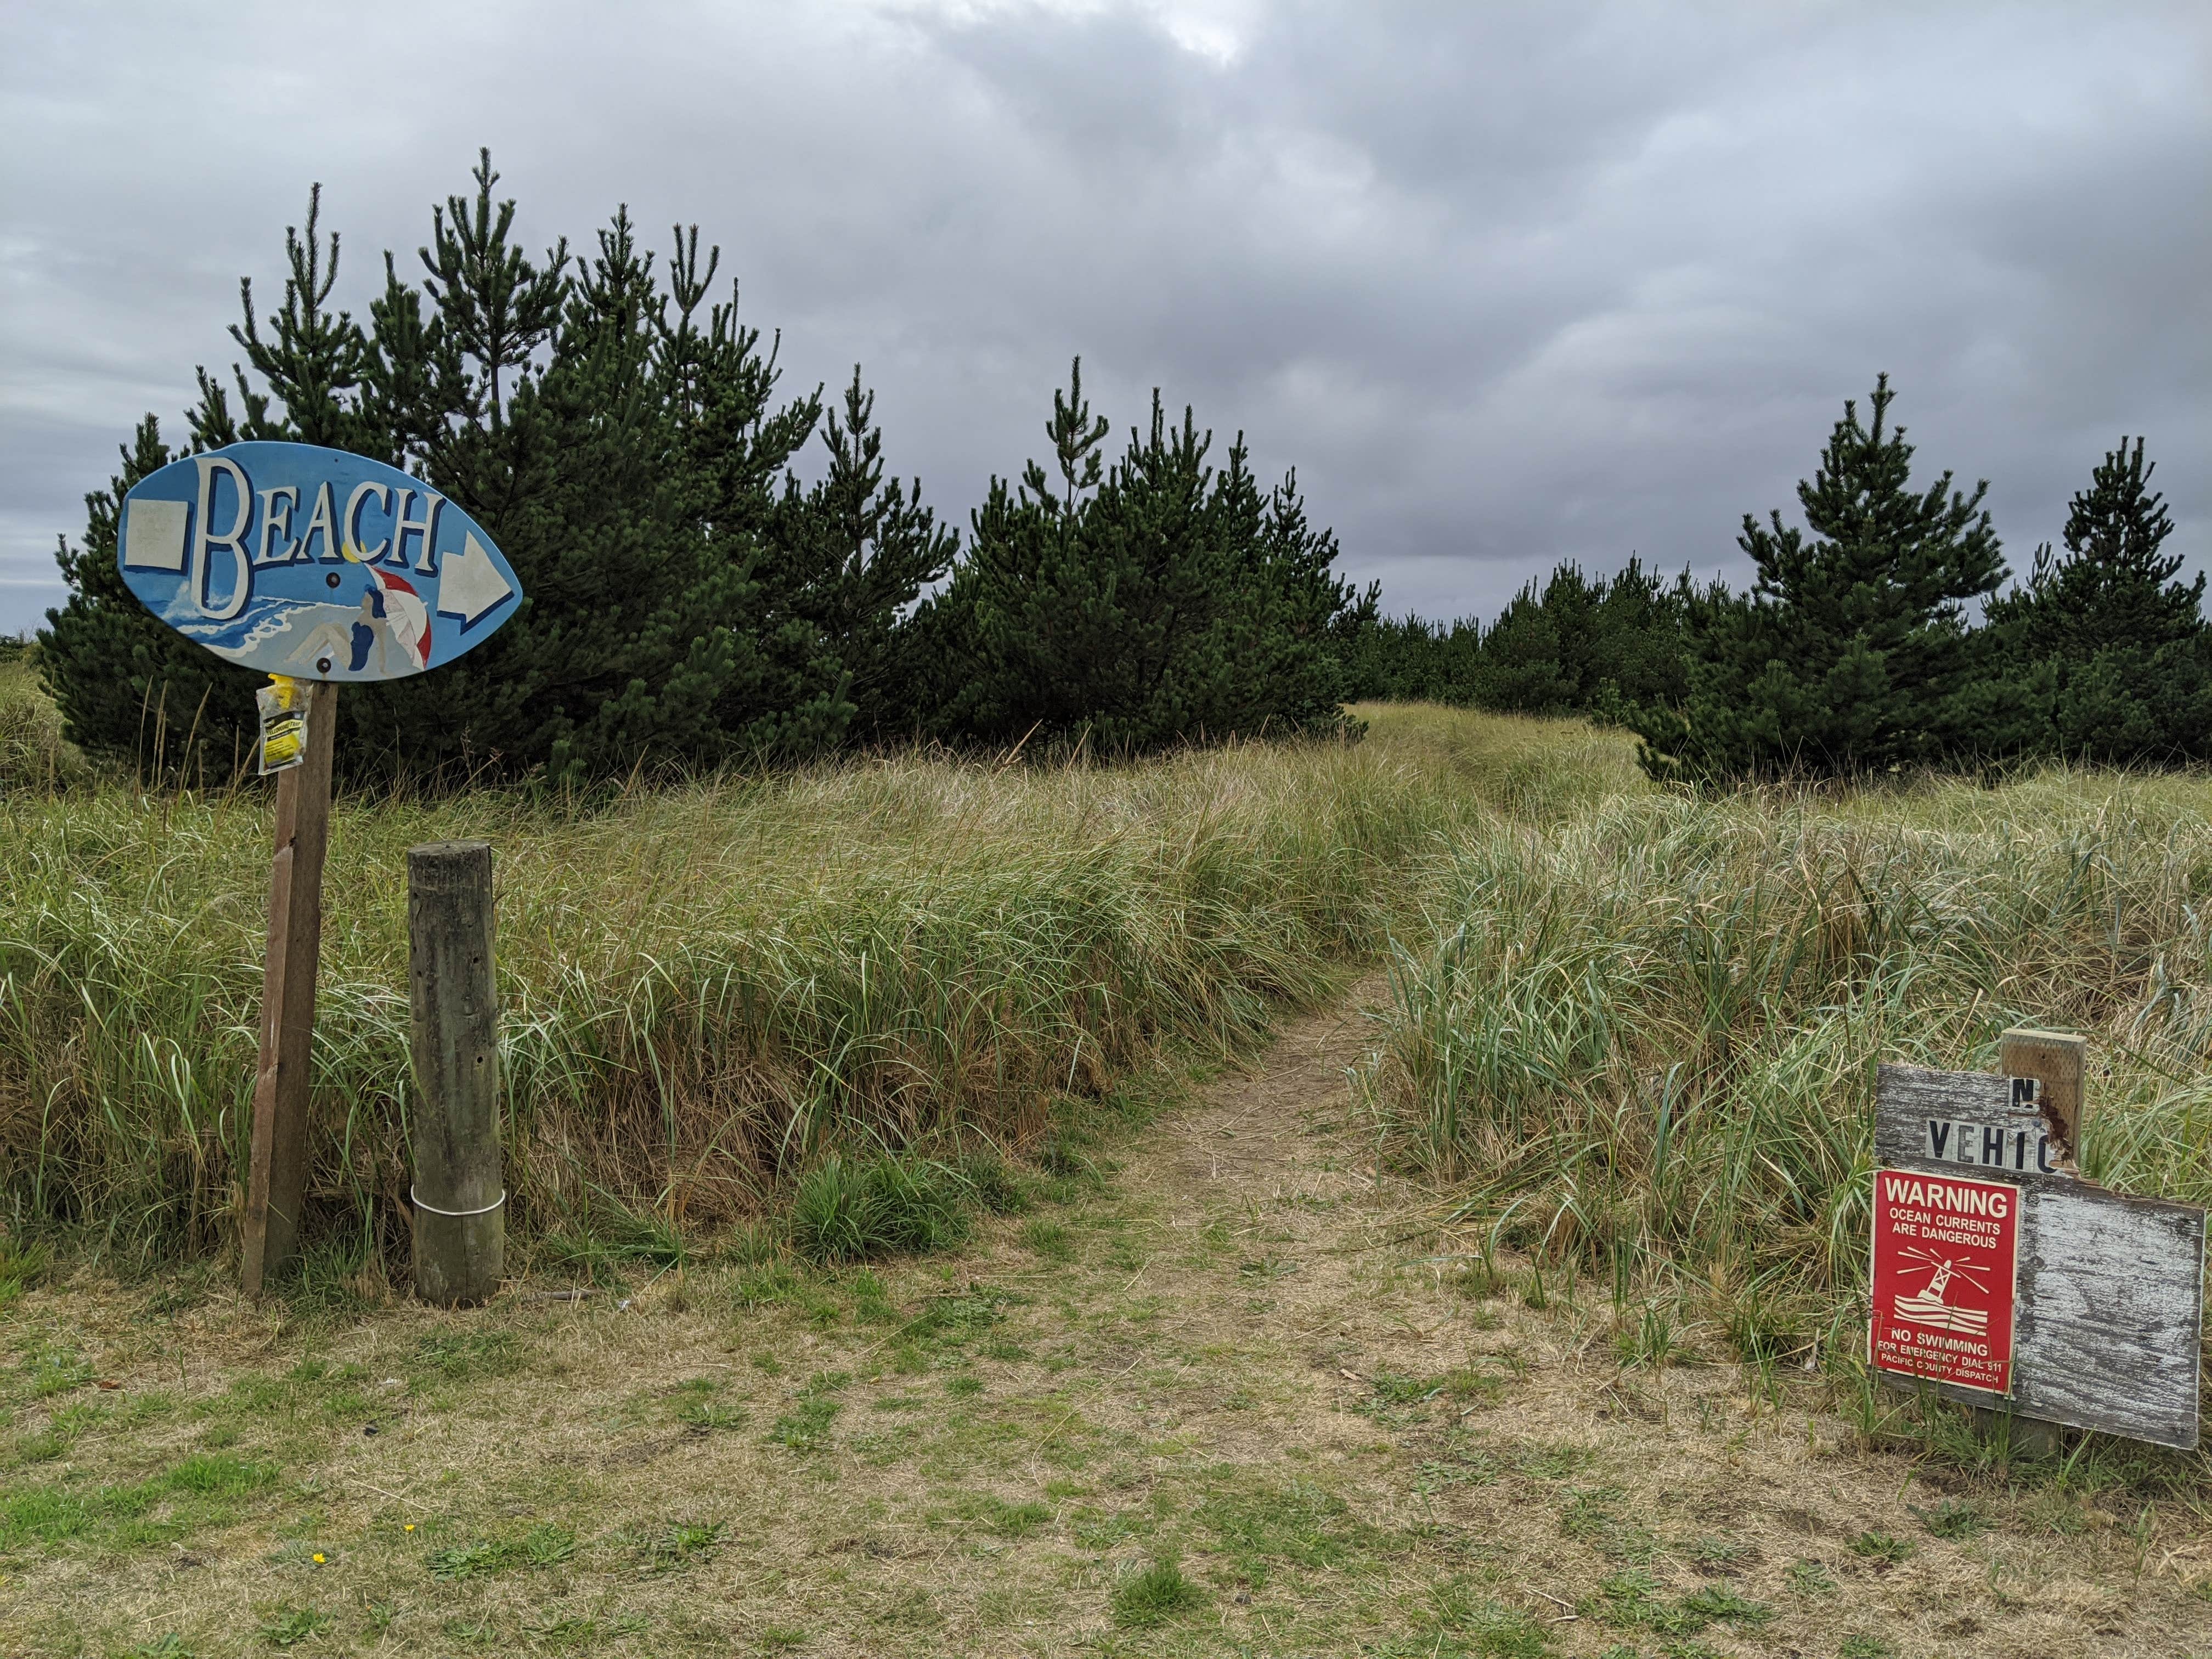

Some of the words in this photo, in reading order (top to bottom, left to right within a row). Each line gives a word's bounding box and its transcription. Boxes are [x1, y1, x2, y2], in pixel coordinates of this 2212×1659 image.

[191, 457, 445, 619] BEACH
[1885, 1177, 2007, 1218] WARNING
[1889, 1207, 1931, 1224] OCEAN
[1936, 1215, 2000, 1234] CURRENTS
[1893, 1222, 1917, 1236] ARE
[1922, 1226, 1996, 1249] DANGEROUS
[1878, 1340, 1897, 1352] FOR
[1900, 1345, 1958, 1363] EMERGENCY
[1962, 1357, 1984, 1369] DIAL
[1988, 1363, 2001, 1372] 911
[1892, 1328, 1911, 1342] NO
[1917, 1333, 1988, 1356] SWIMMING
[1881, 1353, 1913, 1366] PACIFIC
[1956, 1368, 1999, 1383] DISPATCH
